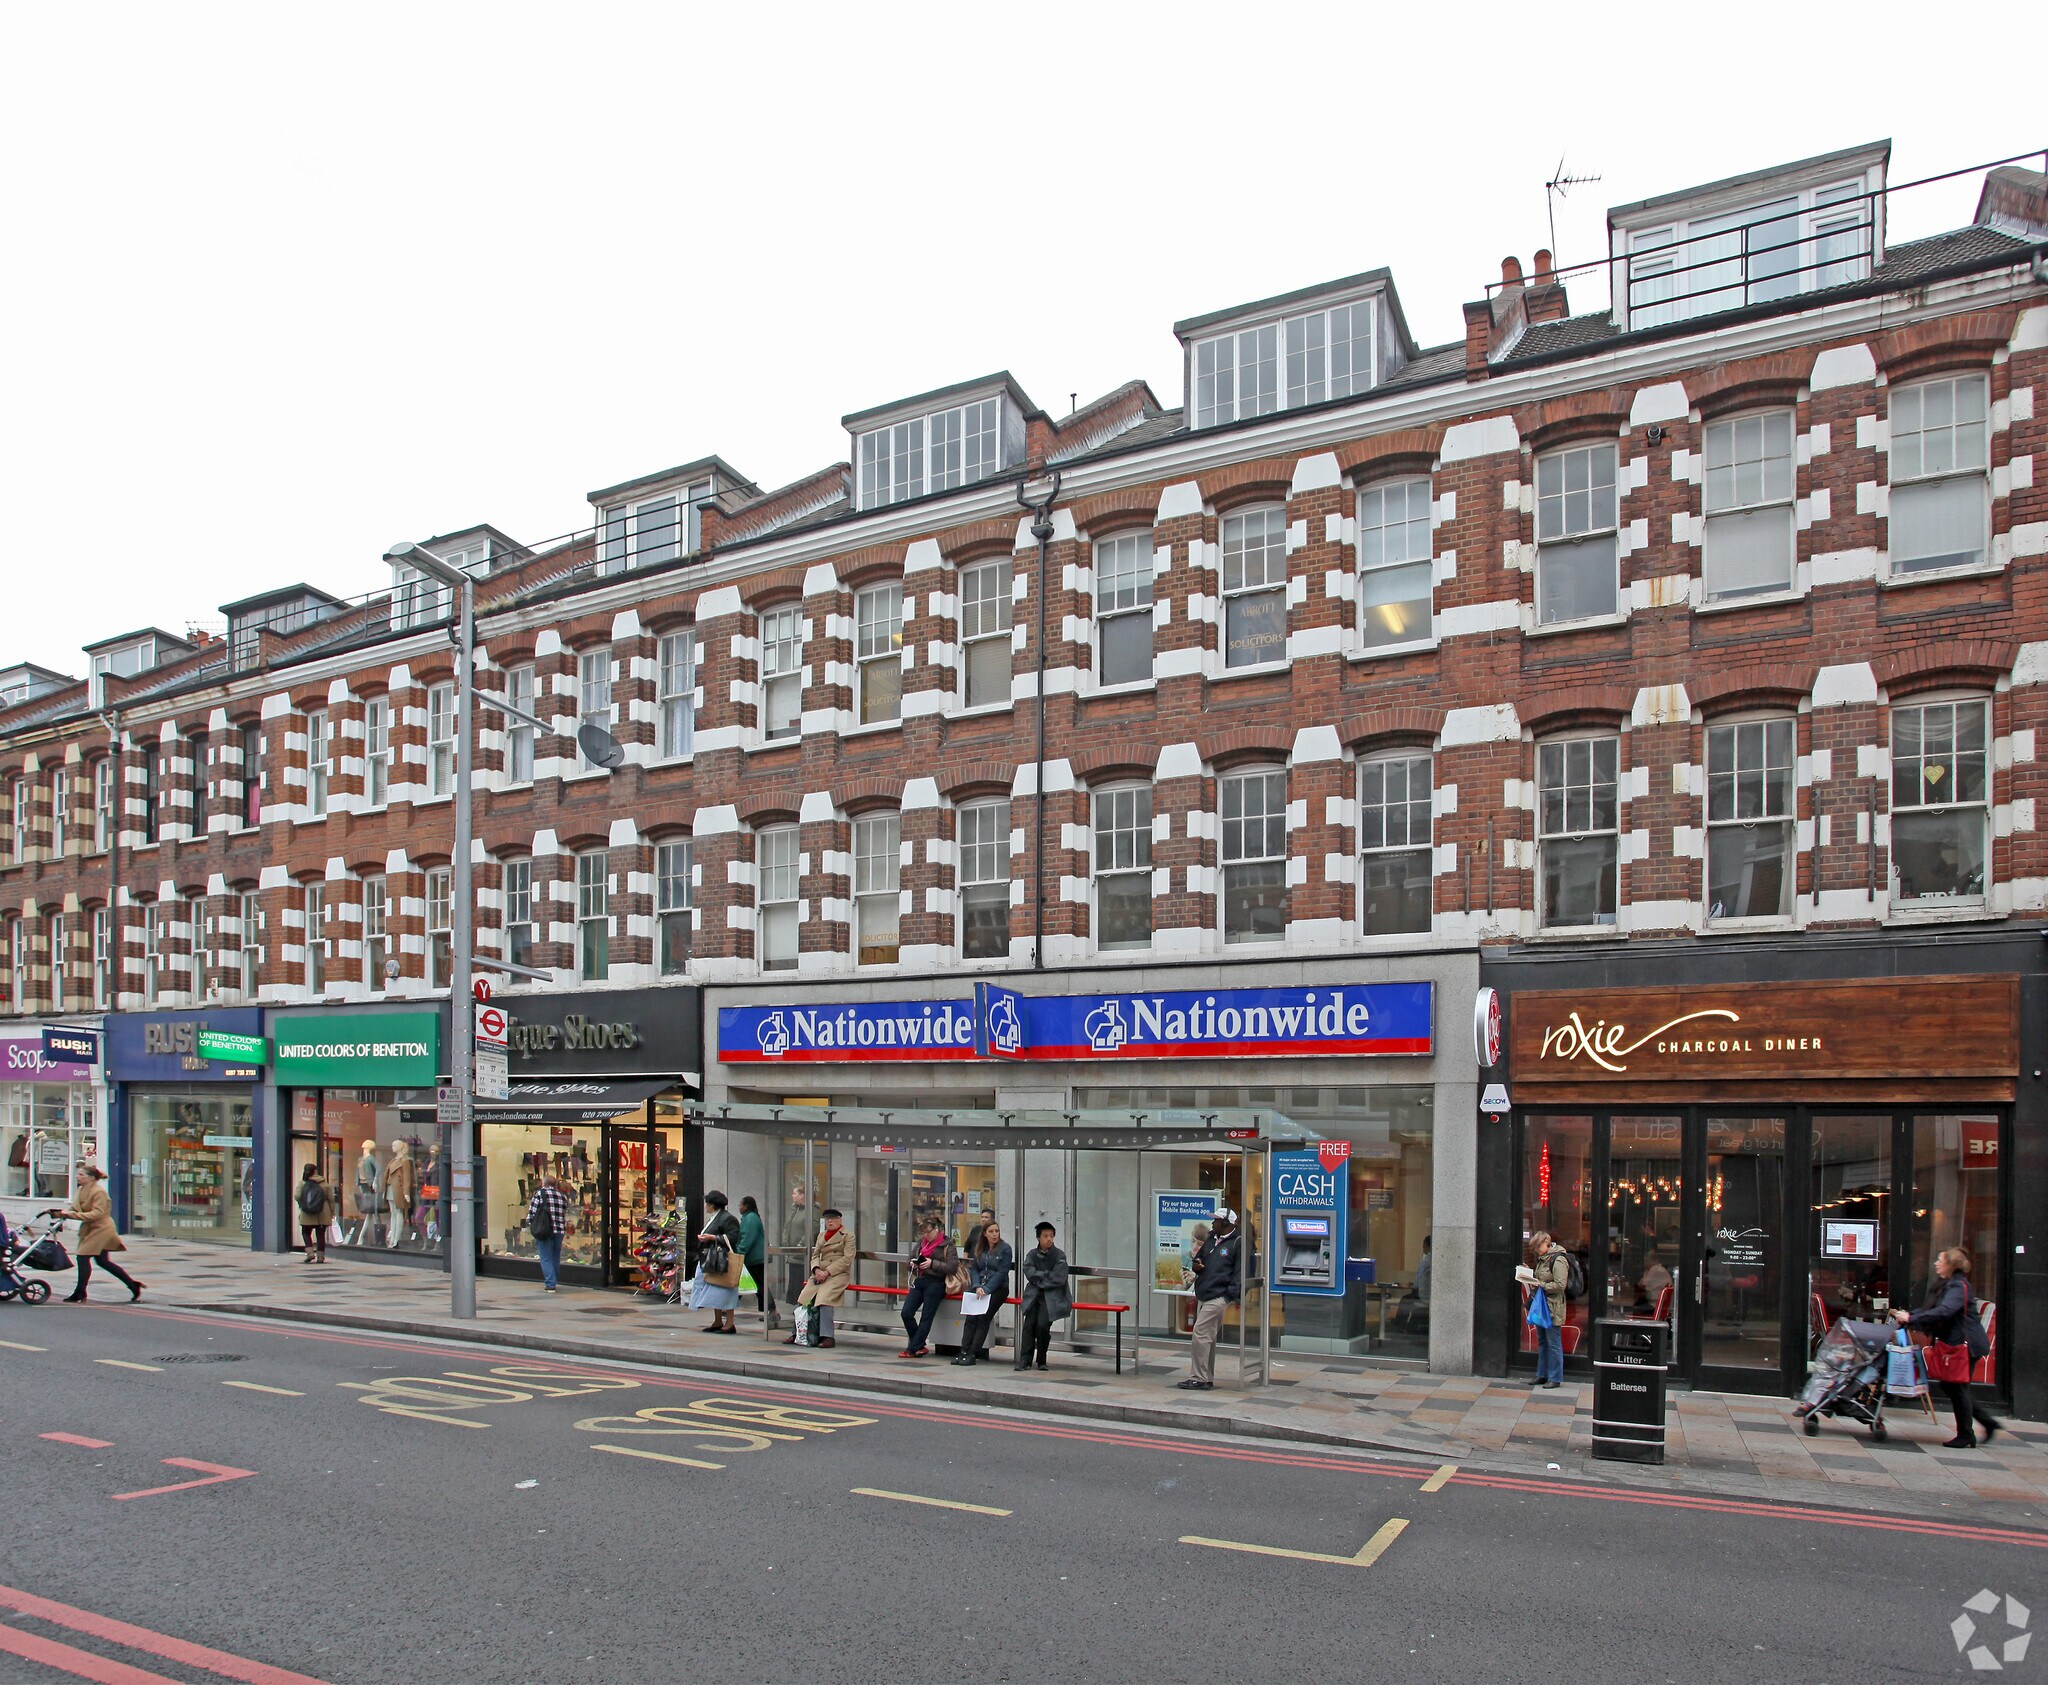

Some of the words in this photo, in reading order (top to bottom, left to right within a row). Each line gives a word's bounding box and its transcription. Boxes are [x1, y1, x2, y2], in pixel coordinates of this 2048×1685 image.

[1240, 602, 1275, 617] ABBOTT
[1230, 633, 1284, 650] SOLICITORS
[479, 981, 488, 999] Y
[1131, 992, 1370, 1042] Nationwide
[564, 1014, 639, 1050] Shoes
[792, 1005, 972, 1048] Nationwide
[51, 1037, 92, 1051] RUSH
[199, 1031, 229, 1043] UNITED
[230, 1035, 261, 1046] COLORS
[199, 1039, 211, 1047] OF
[1658, 1040, 1752, 1054] CHARCOAL
[1765, 1037, 1822, 1051] DINER
[279, 1044, 314, 1058] UNITED
[315, 1043, 355, 1058] COLORS
[356, 1043, 370, 1057] OF
[372, 1042, 429, 1057] BENETTON.
[508, 1083, 548, 1096] ique
[581, 1111, 596, 1119] 020
[1319, 1142, 1348, 1156] FREE
[1278, 1174, 1335, 1196] CASH
[1162, 1200, 1170, 1208] Try
[1278, 1196, 1334, 1206] WITHDRAWALS
[1179, 1207, 1200, 1215] Banking
[1296, 1222, 1325, 1231] Nationwide
[1617, 1355, 1643, 1364] Litter
[1610, 1382, 1647, 1392] Battersea
[573, 1398, 879, 1452] BUS
